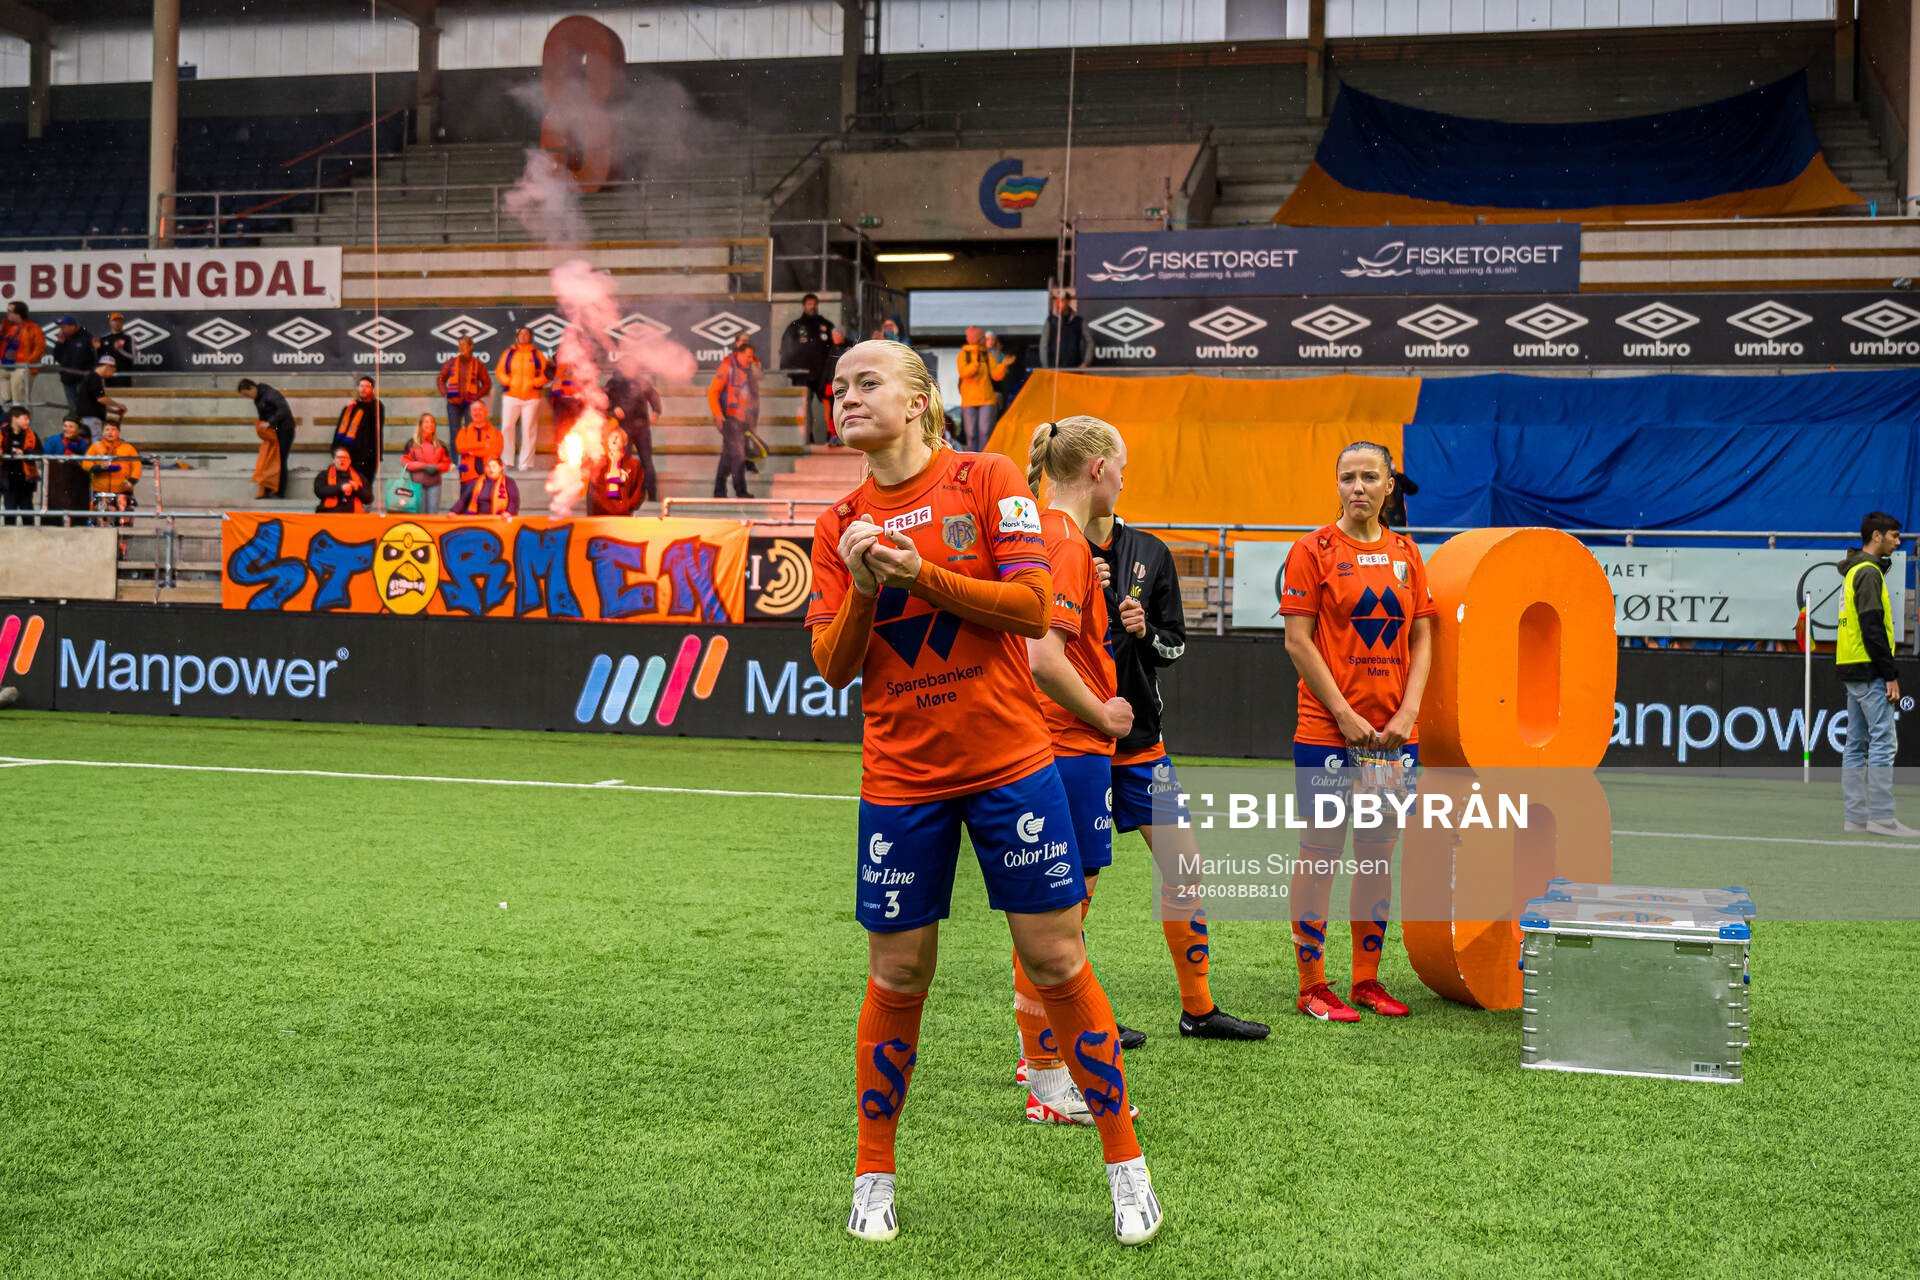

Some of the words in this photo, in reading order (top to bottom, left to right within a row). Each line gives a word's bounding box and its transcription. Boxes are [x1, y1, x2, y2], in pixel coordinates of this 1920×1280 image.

[1150, 250, 1298, 269] FISKETORGET
[1406, 246, 1562, 264] FISKETORGET
[30, 259, 326, 299] BUSENGDAL
[1449, 266, 1483, 276] catering
[1495, 266, 1517, 274] sushi
[1095, 343, 1156, 359] umbro
[1196, 342, 1259, 358] umbro
[1298, 342, 1362, 358] umbro
[1404, 342, 1470, 358] umbro
[1513, 341, 1578, 357] umbro
[1623, 341, 1690, 357] umbro
[1734, 340, 1803, 357] umbro
[1850, 340, 1919, 356] umbro
[192, 351, 244, 365] umbro
[273, 351, 325, 365] umbro
[353, 351, 406, 365] umbro
[1612, 594, 1730, 623] ØRTZ
[1349, 655, 1402, 666] Sparebanke
[1367, 667, 1390, 677] Møre
[886, 665, 984, 697] Sparebanken
[916, 691, 957, 709] Møre
[1338, 775, 1351, 787] Lin
[1004, 848, 1042, 867] Color
[1043, 841, 1068, 860] Line
[881, 868, 915, 885] Line
[884, 890, 900, 919] 3
